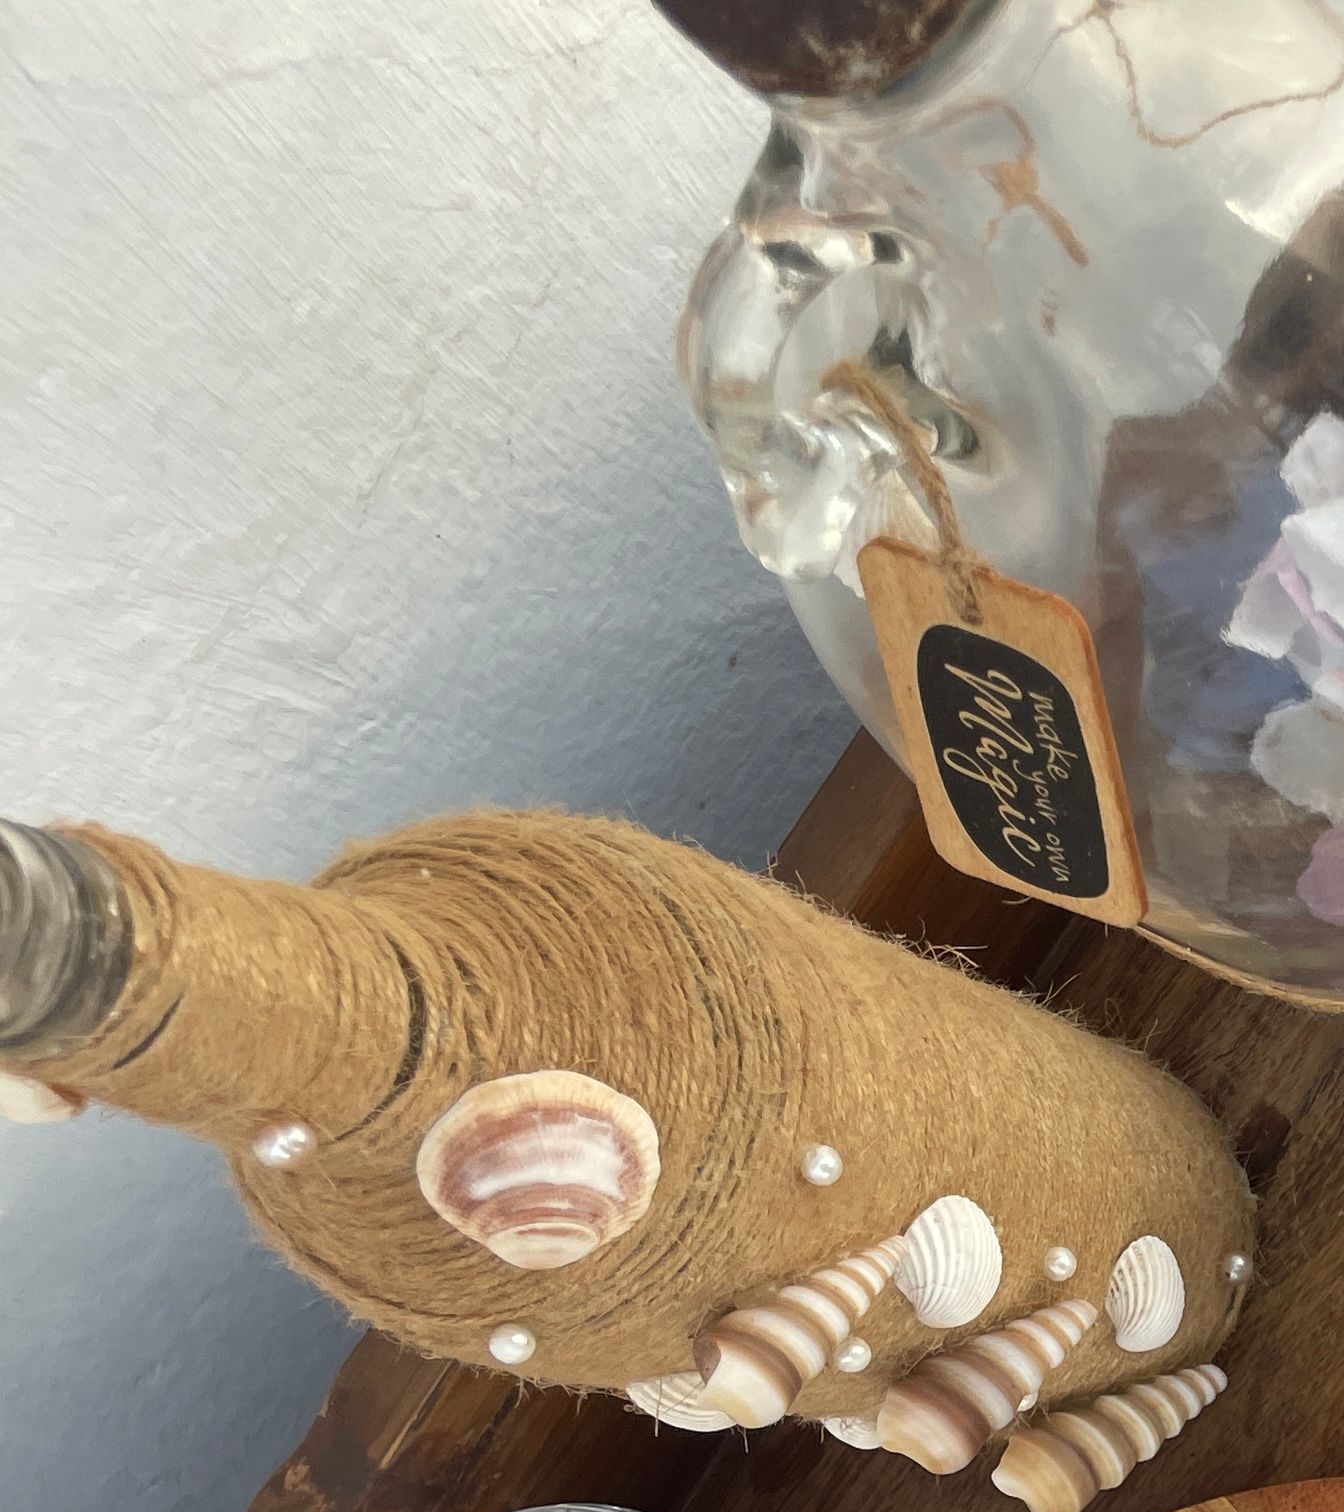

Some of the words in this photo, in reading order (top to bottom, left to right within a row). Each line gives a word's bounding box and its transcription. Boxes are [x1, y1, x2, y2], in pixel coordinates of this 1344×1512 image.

[942, 661, 1042, 868] Magic
[1028, 690, 1078, 783] make
[1013, 759, 1057, 827] your
[1046, 832, 1071, 884] own
